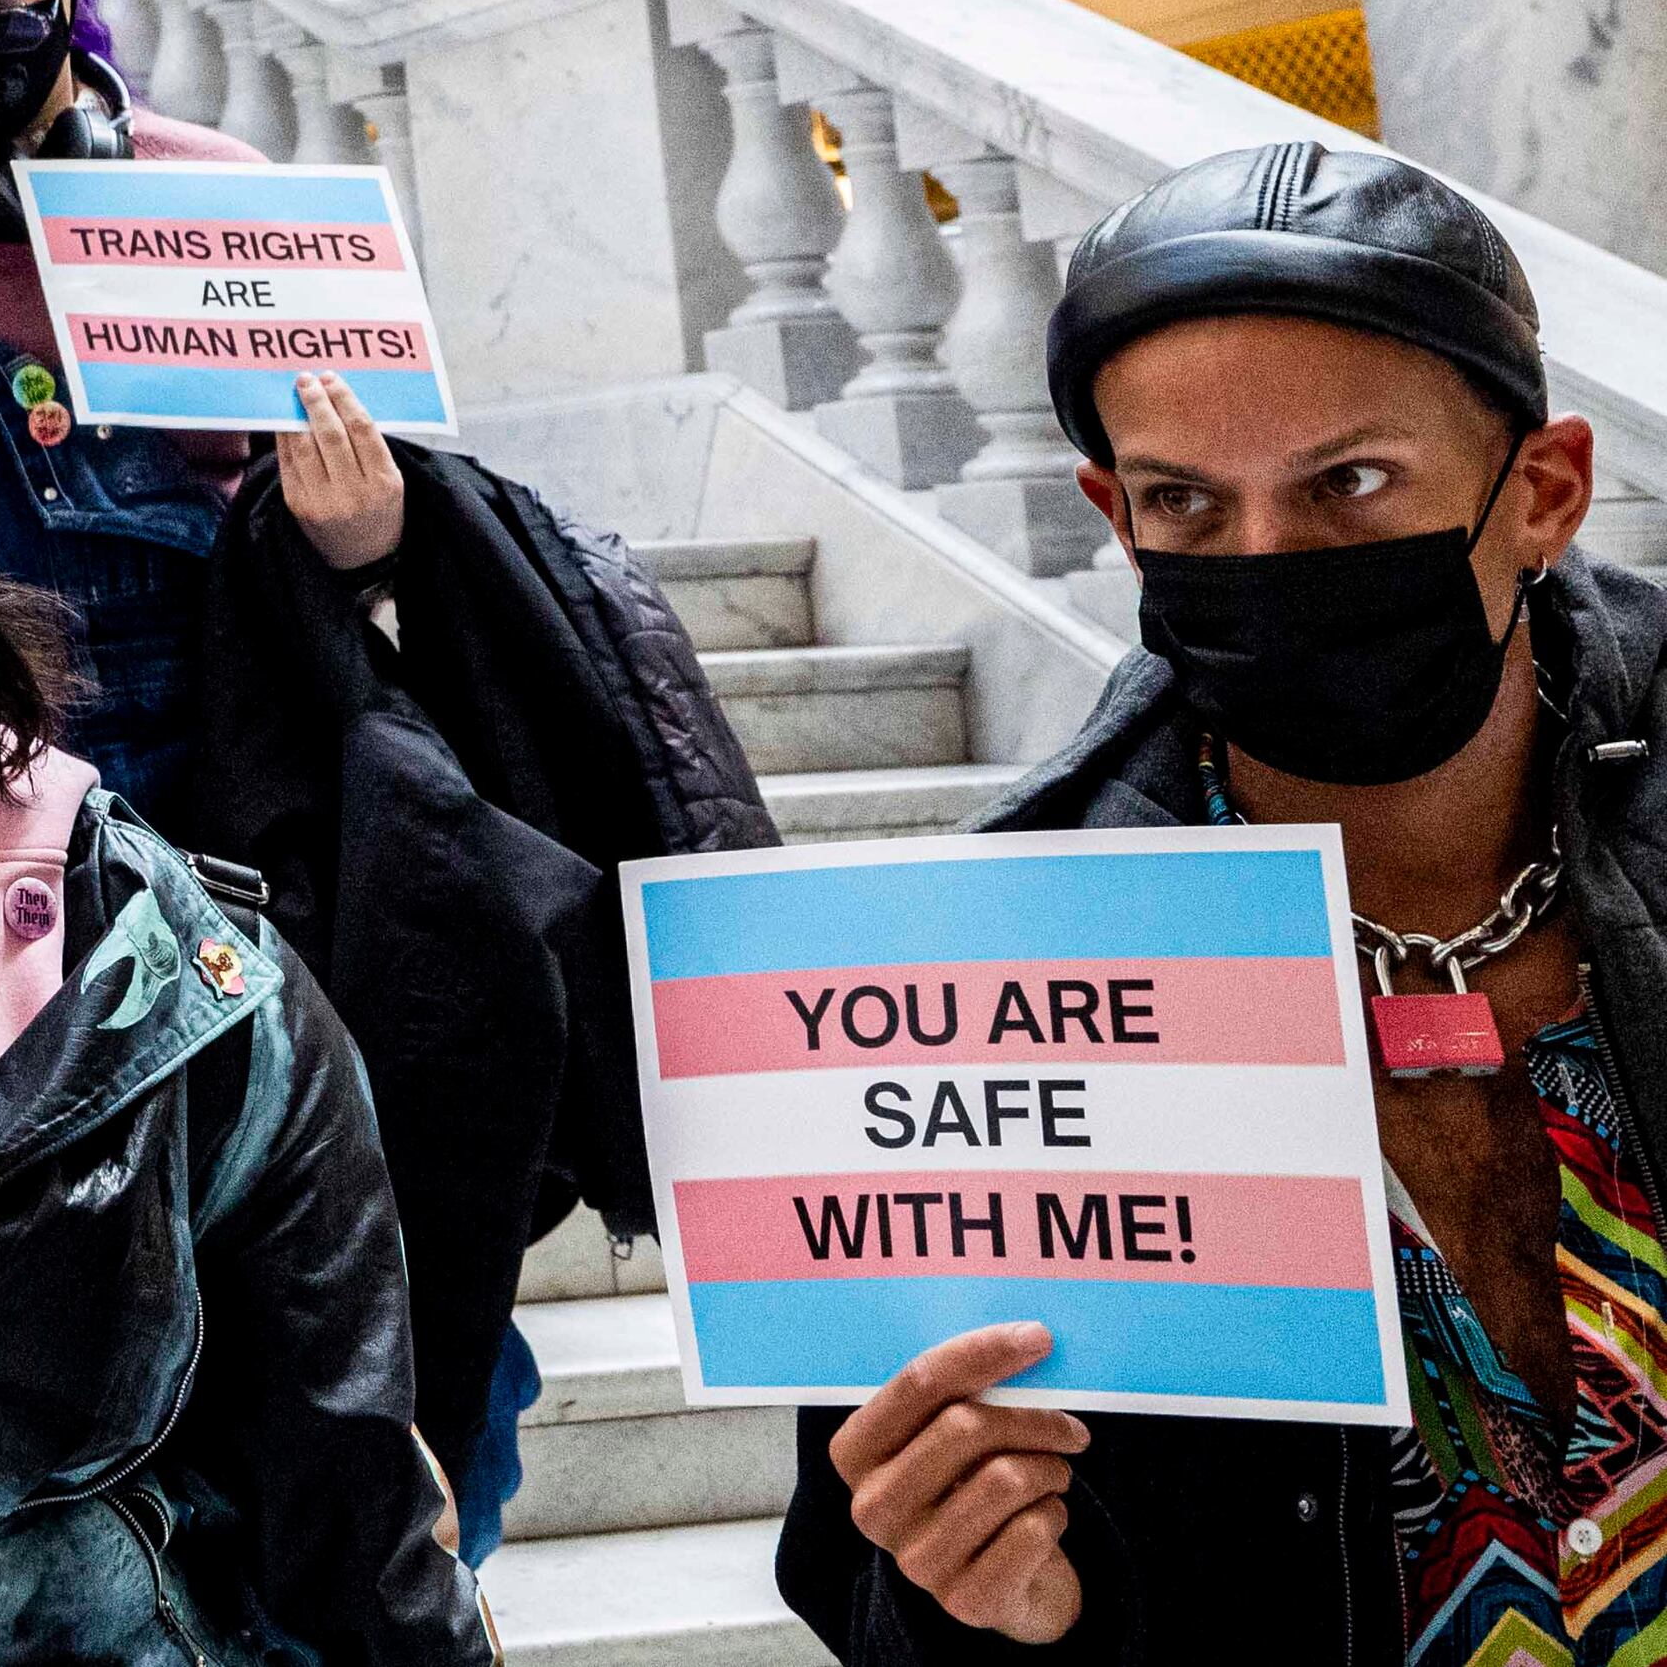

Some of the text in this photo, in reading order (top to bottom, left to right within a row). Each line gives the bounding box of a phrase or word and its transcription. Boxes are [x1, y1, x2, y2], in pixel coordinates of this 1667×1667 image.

[70, 228, 376, 263] TRANS RIGHTS
[201, 280, 276, 308] ARE
[83, 322, 417, 361] HUMAN RIGHTS!
[14, 905, 51, 928] Them
[16, 888, 48, 910] They
[783, 978, 1160, 1051] YOU ARE
[863, 1078, 1093, 1151] SAFE
[791, 1191, 1196, 1264] WITH ME!
